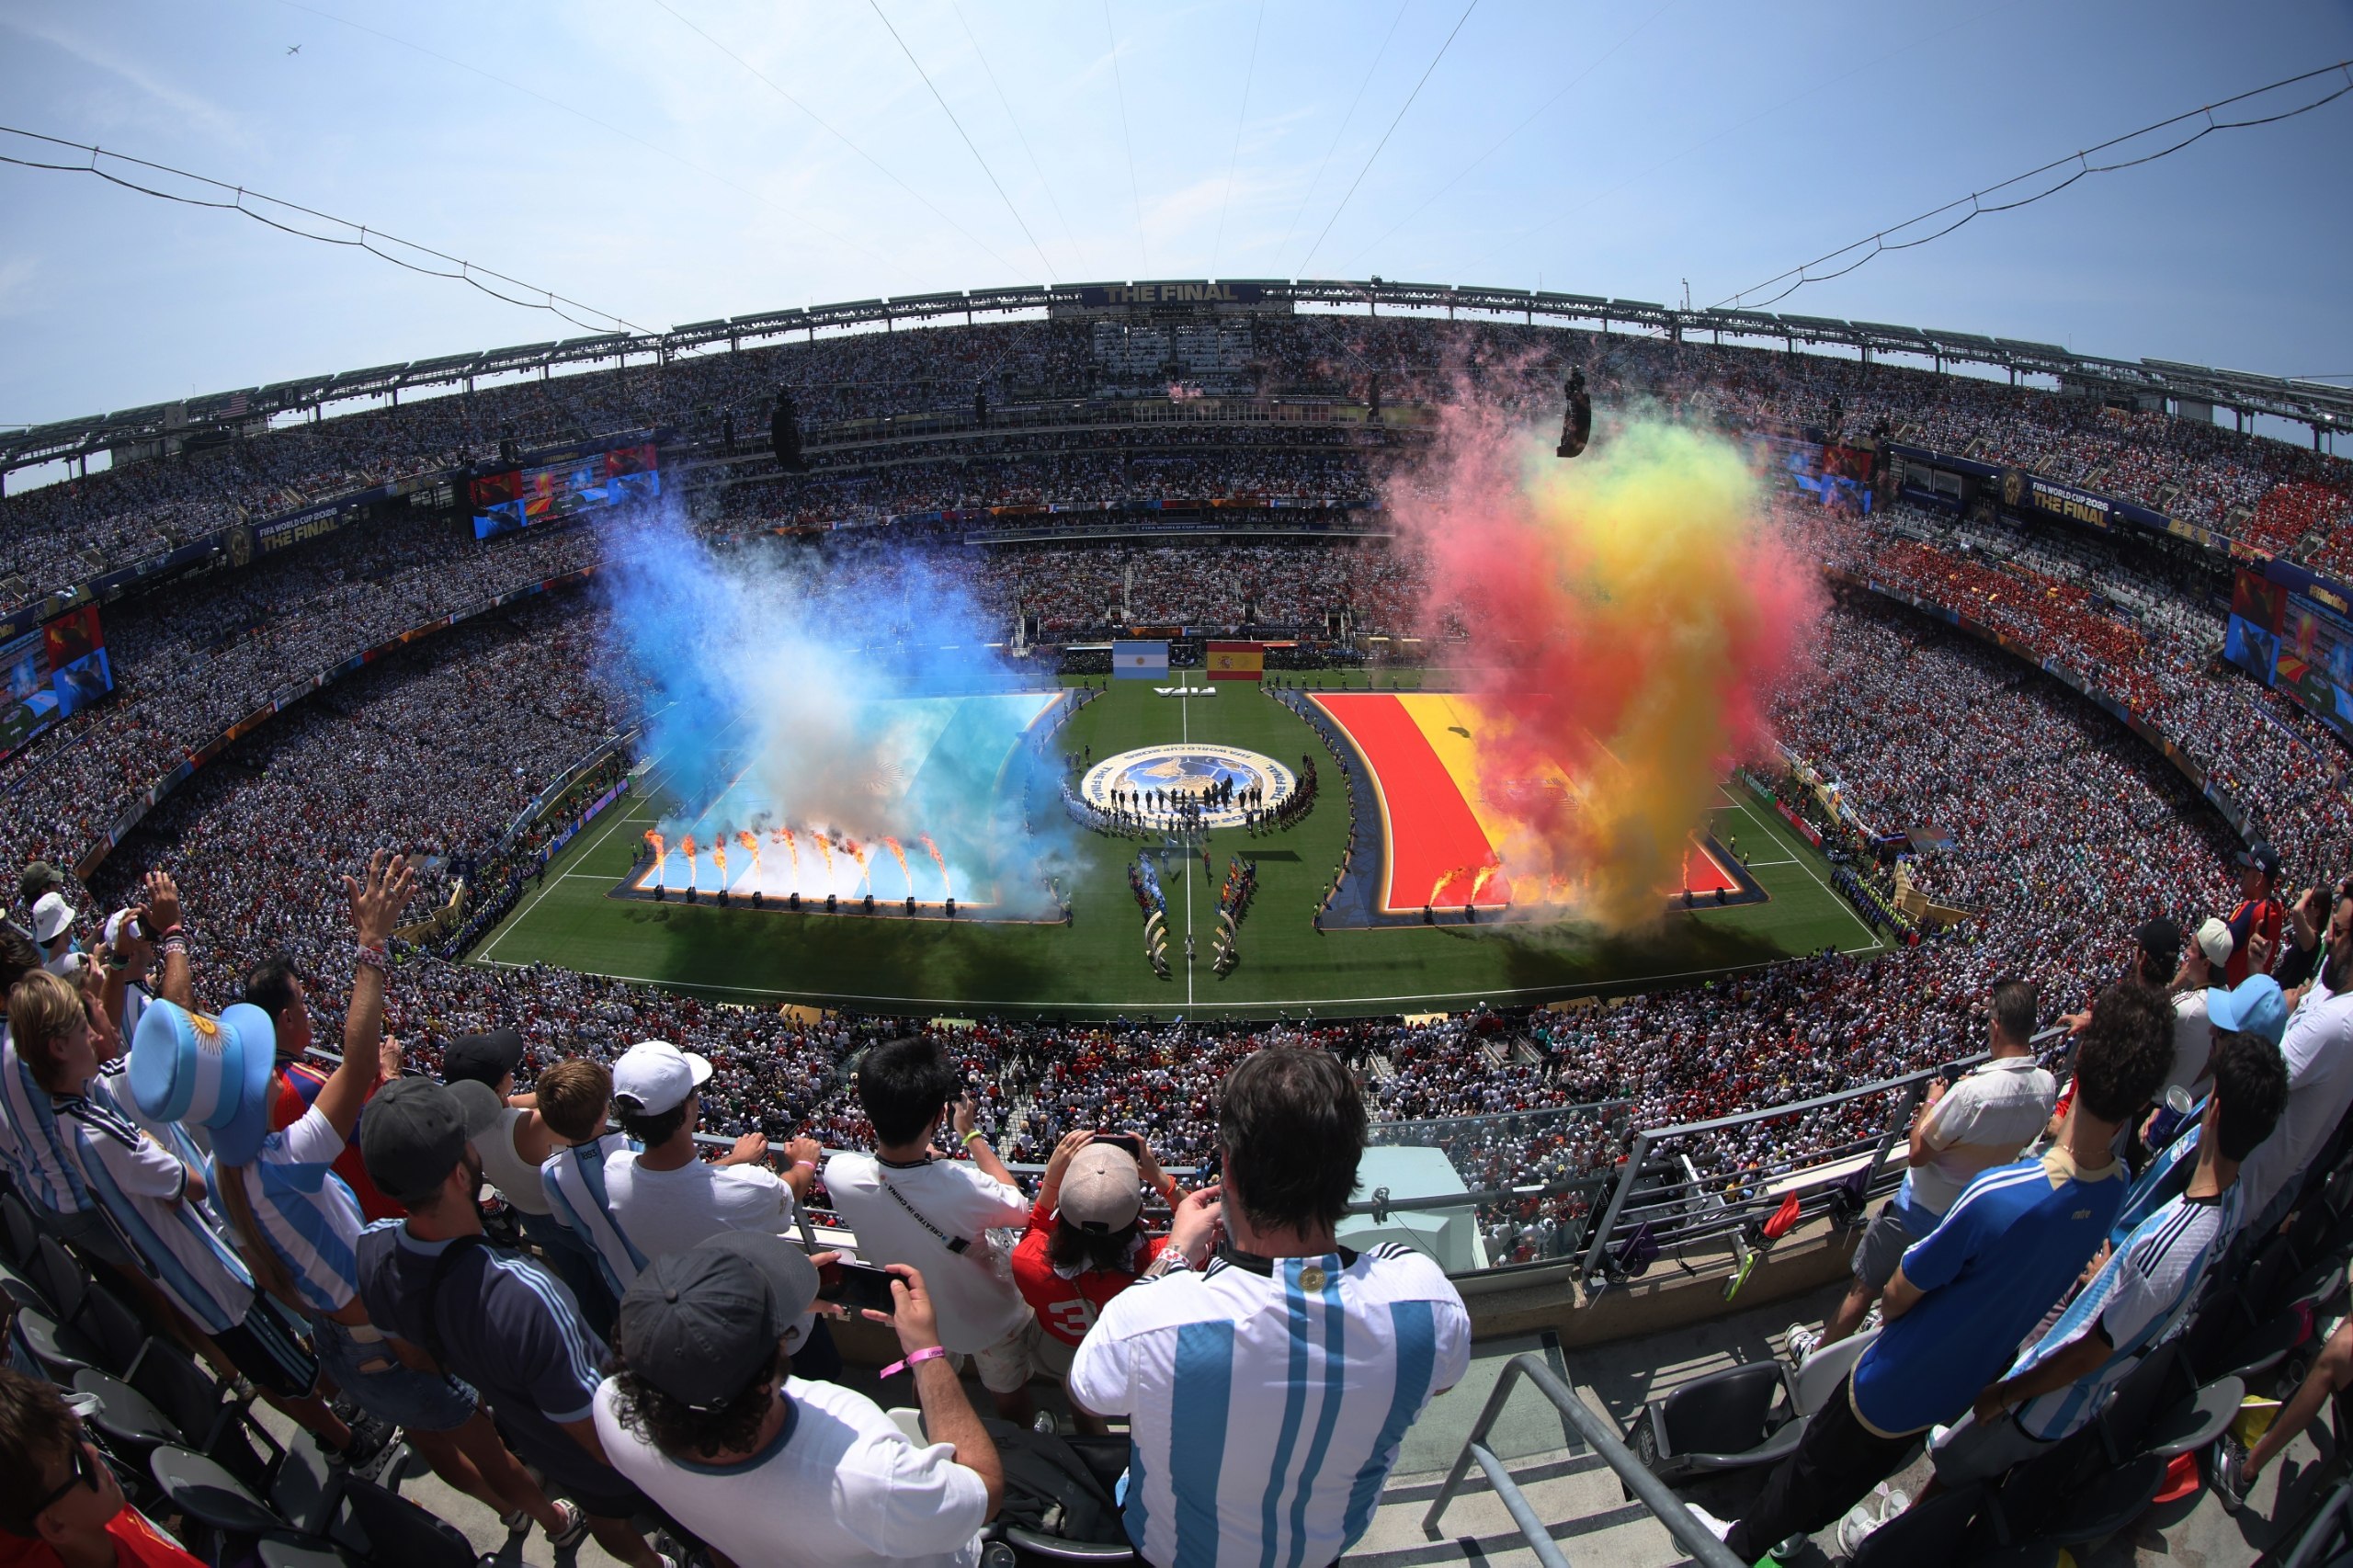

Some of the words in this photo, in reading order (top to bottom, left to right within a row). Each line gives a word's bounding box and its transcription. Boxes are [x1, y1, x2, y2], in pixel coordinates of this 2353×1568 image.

[1104, 286, 1155, 302] THE
[1162, 285, 1239, 301] FINAL
[2032, 482, 2047, 494] FIFA
[2047, 485, 2071, 500] WORLD
[2072, 493, 2086, 504] CUP
[2086, 497, 2109, 512] 2026
[2032, 491, 2062, 514] THE
[2063, 500, 2108, 528] FINAL
[259, 527, 276, 538] FIFA
[275, 518, 300, 533] WORLD
[300, 515, 313, 526] CUP
[313, 507, 338, 520] 2026
[261, 529, 293, 551] THE
[294, 517, 339, 542] FINAL
[1153, 687, 1216, 697] FIFA
[1093, 767, 1114, 780] THE
[1266, 764, 1287, 785] FINAL
[1090, 779, 1107, 802] FINAL
[1269, 786, 1287, 801] THE
[558, 828, 573, 846] VISA
[887, 1184, 907, 1206] CHINA
[905, 1204, 915, 1214] IN
[914, 1211, 944, 1238] CREATED
